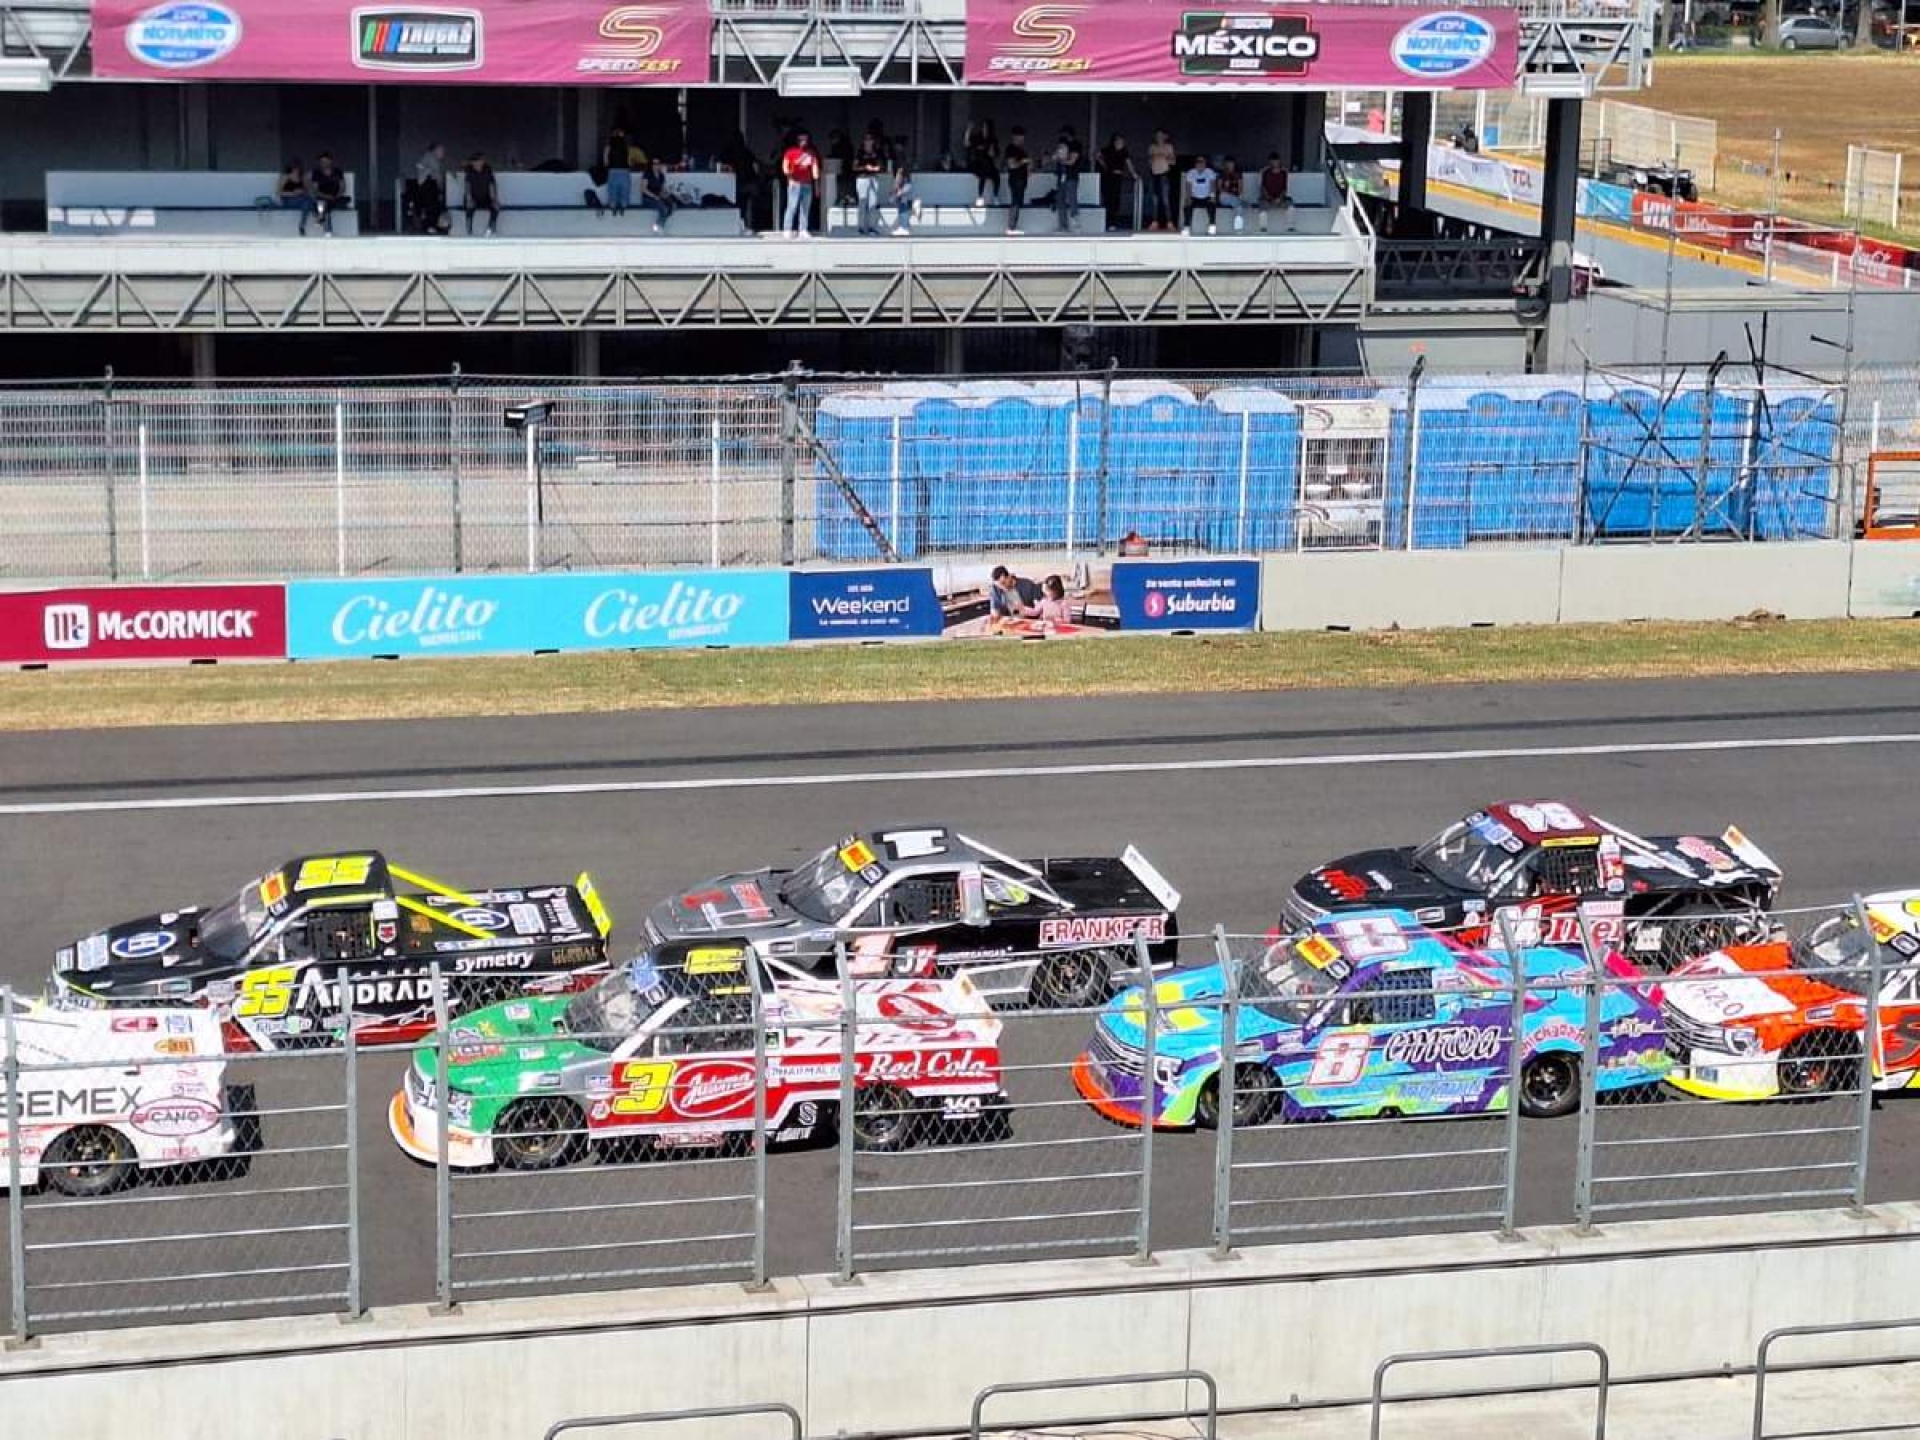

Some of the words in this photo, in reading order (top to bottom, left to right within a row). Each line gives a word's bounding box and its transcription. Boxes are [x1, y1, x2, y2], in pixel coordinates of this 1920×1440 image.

[1174, 30, 1317, 57] MÉXICO
[576, 58, 682, 72] SPEEDFEST
[988, 57, 1093, 71] SPEEDFEST
[332, 586, 498, 645] Cielito
[585, 581, 745, 639] Cielito
[812, 596, 910, 615] Weekend
[1167, 592, 1236, 615] Suburbia
[98, 609, 255, 641] McCORMICK
[455, 951, 534, 974] symetry
[239, 968, 297, 1018] 55
[866, 1053, 923, 1081] Red
[928, 1049, 987, 1077] Cola
[1305, 1033, 1372, 1087] 8
[613, 1061, 678, 1114] 3
